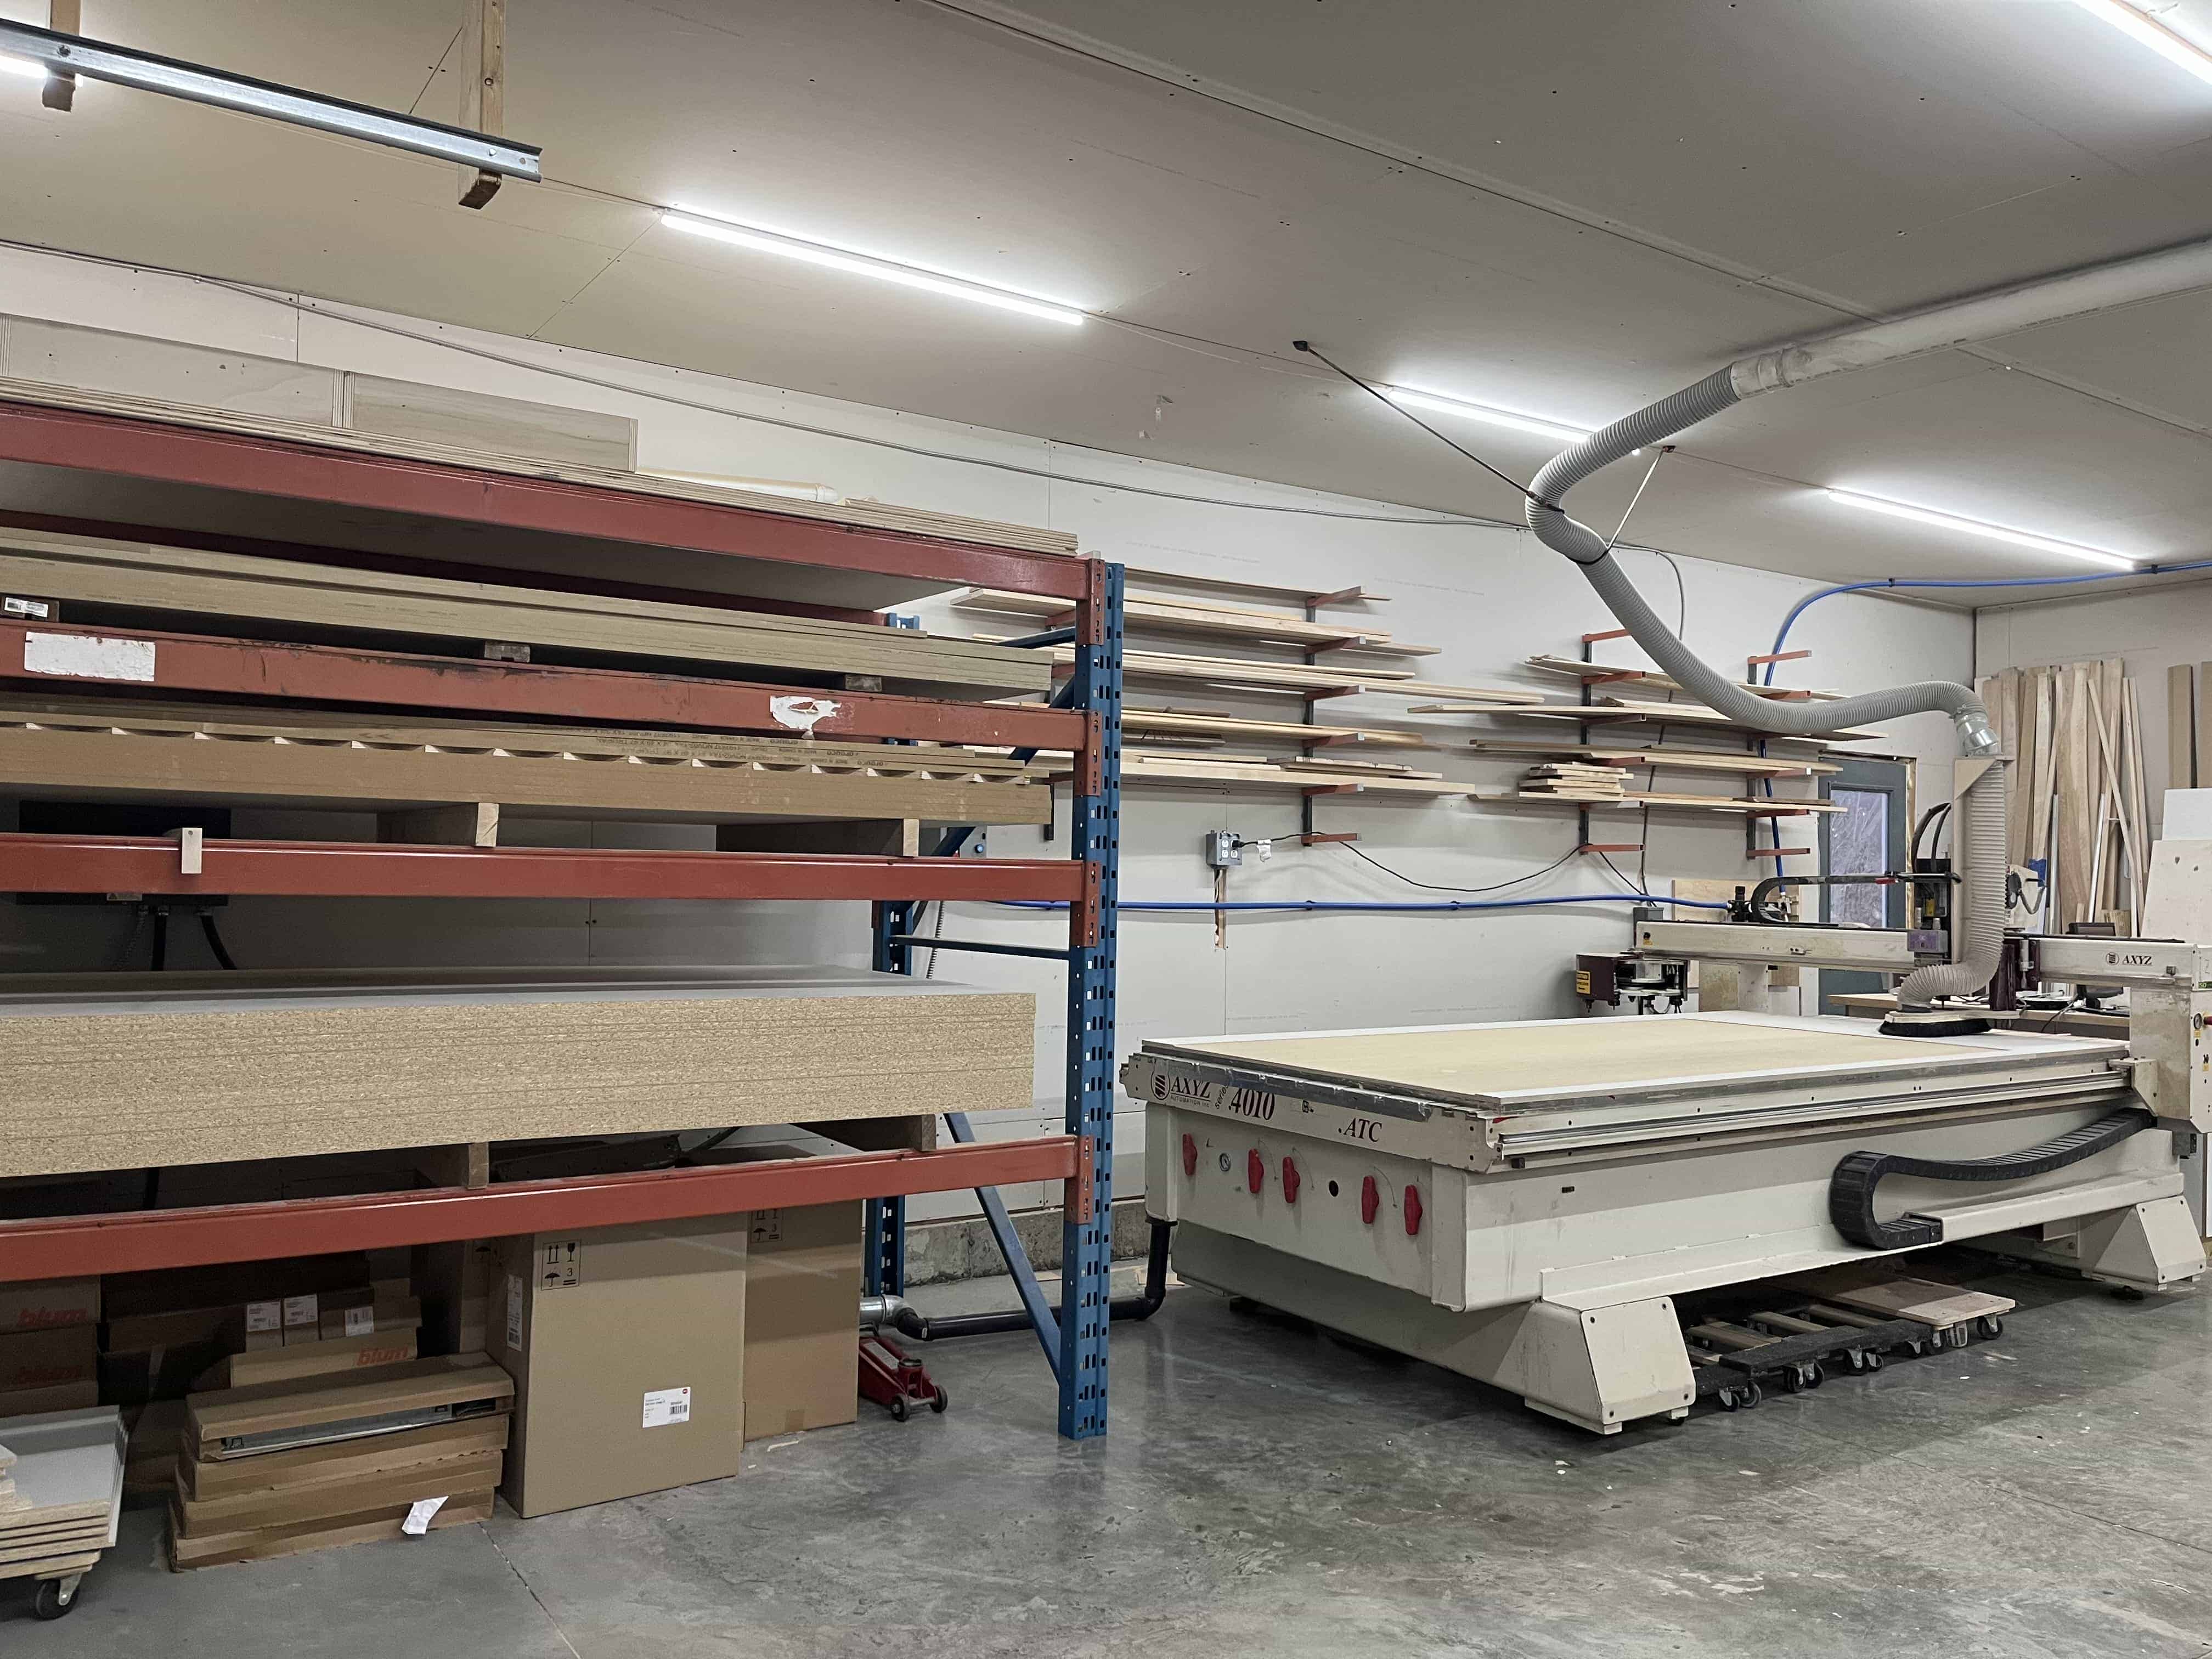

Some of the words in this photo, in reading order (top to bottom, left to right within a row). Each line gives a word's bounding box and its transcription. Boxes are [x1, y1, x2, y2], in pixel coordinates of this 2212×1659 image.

[2122, 955, 2152, 966] AXYZ
[1170, 1076, 1211, 1098] AXYZ
[567, 1267, 573, 1277] 3
